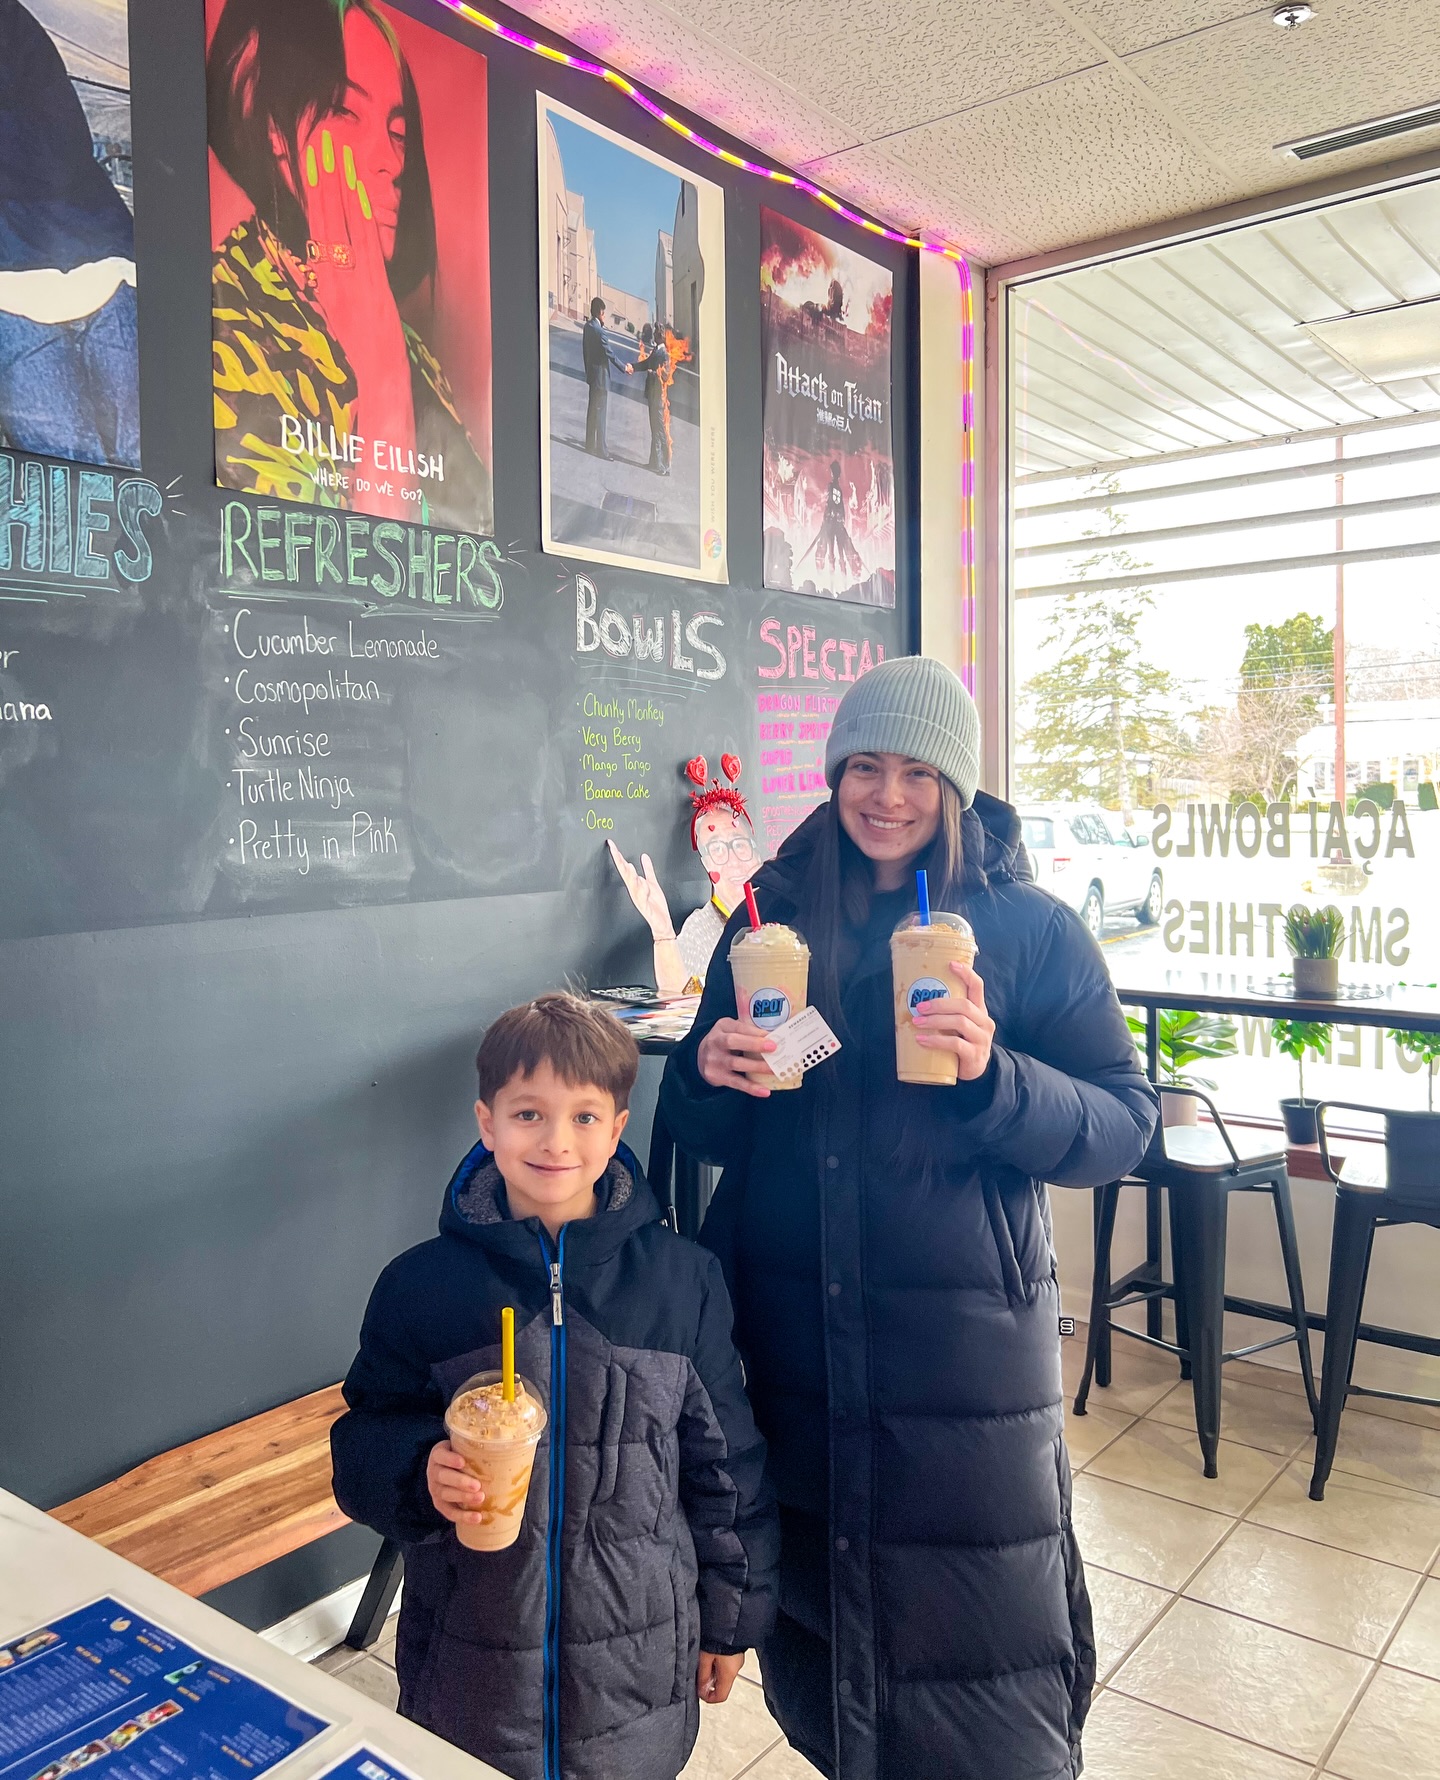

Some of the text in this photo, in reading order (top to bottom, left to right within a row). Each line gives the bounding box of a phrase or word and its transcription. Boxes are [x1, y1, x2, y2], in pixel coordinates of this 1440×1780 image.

[775, 352, 883, 424] Attack on Titan
[281, 413, 444, 482] BILLIE EILISH
[309, 466, 422, 505] WHERE DO WE GO?
[224, 501, 502, 609] REFRESHERS
[233, 608, 440, 659] Cucumber Lemonade
[575, 573, 727, 680] BOWLS
[235, 668, 380, 715] Cosmopolitan
[583, 692, 664, 727] Chunky Monkey
[757, 693, 841, 713] DRAGON FLIRT
[0, 701, 53, 722] ana
[797, 720, 832, 740] SPRIT
[239, 716, 331, 758] Sunrise
[581, 726, 641, 753] Very Berry
[582, 753, 651, 778] Mango Tango
[232, 765, 355, 810] Turtle Ninja
[583, 779, 651, 801] Banana Cake
[586, 809, 614, 830] Oreo
[239, 811, 398, 875] Pretty in Pink
[754, 998, 785, 1014] SPOT
